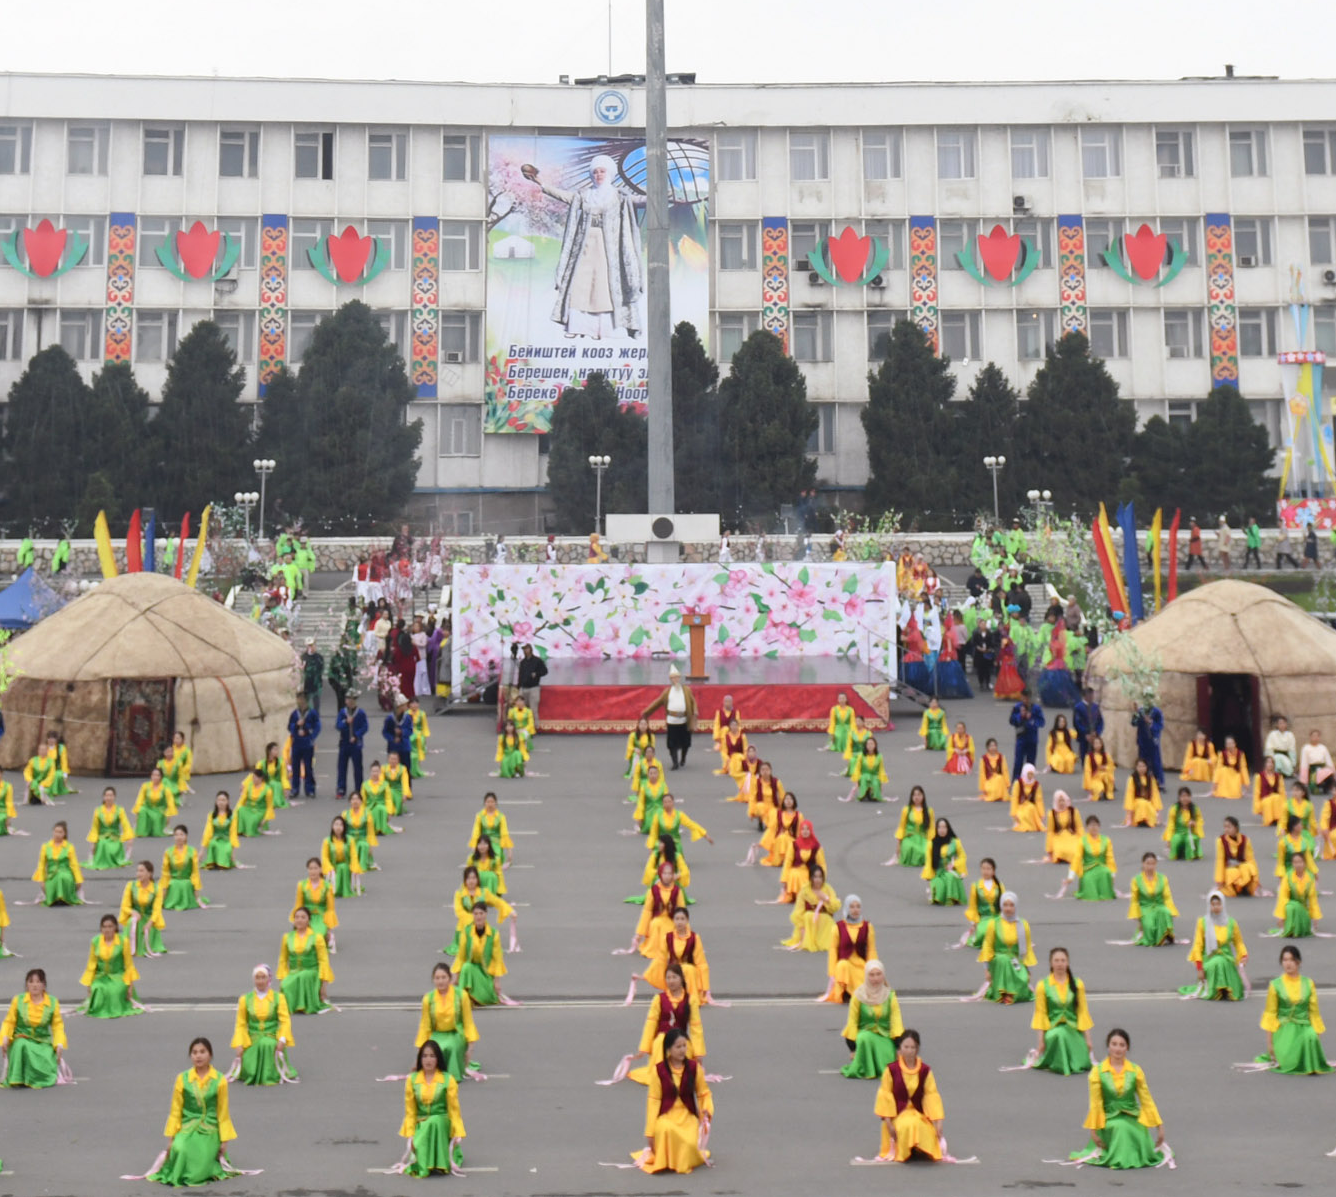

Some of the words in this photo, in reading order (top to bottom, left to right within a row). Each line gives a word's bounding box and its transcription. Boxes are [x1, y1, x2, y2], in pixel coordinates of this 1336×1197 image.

[508, 344, 577, 358] Бейиштей
[582, 347, 613, 358] кооз
[508, 365, 573, 380] Берешен,
[507, 385, 557, 401] Береке
[616, 386, 648, 401] Ноор
